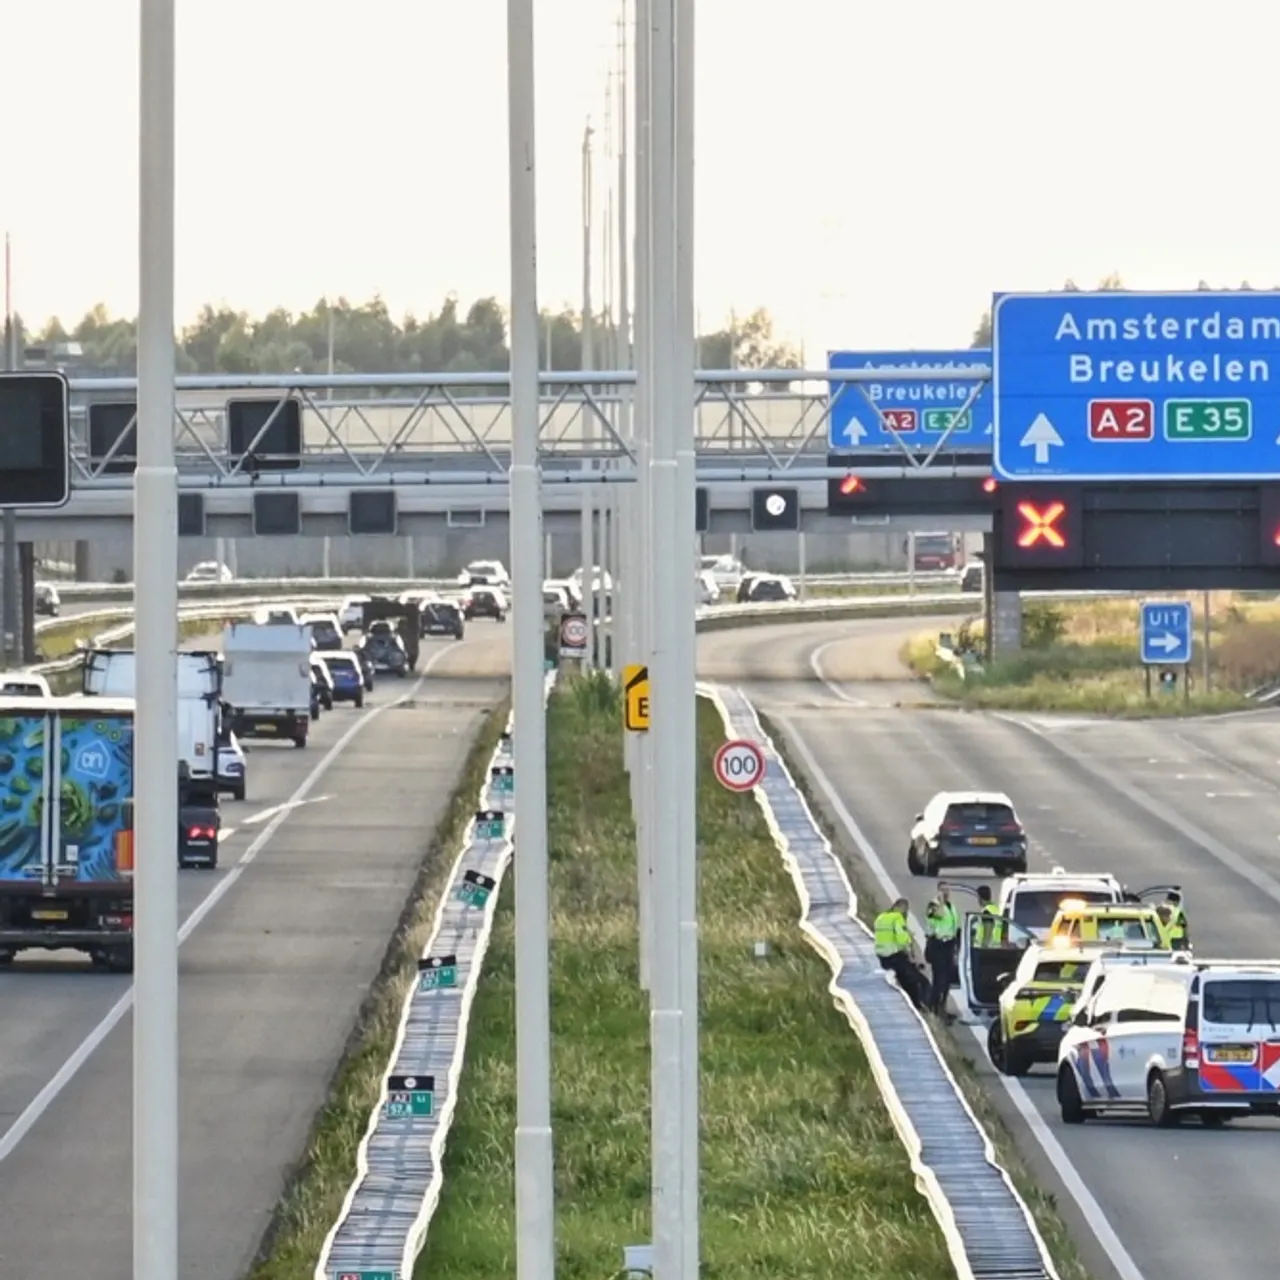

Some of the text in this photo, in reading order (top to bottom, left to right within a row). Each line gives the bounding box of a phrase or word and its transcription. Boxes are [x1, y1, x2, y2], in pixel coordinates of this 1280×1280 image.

[1069, 354, 1270, 383] Breukelen
[1148, 611, 1181, 626] UIT
[723, 755, 756, 775] 100
